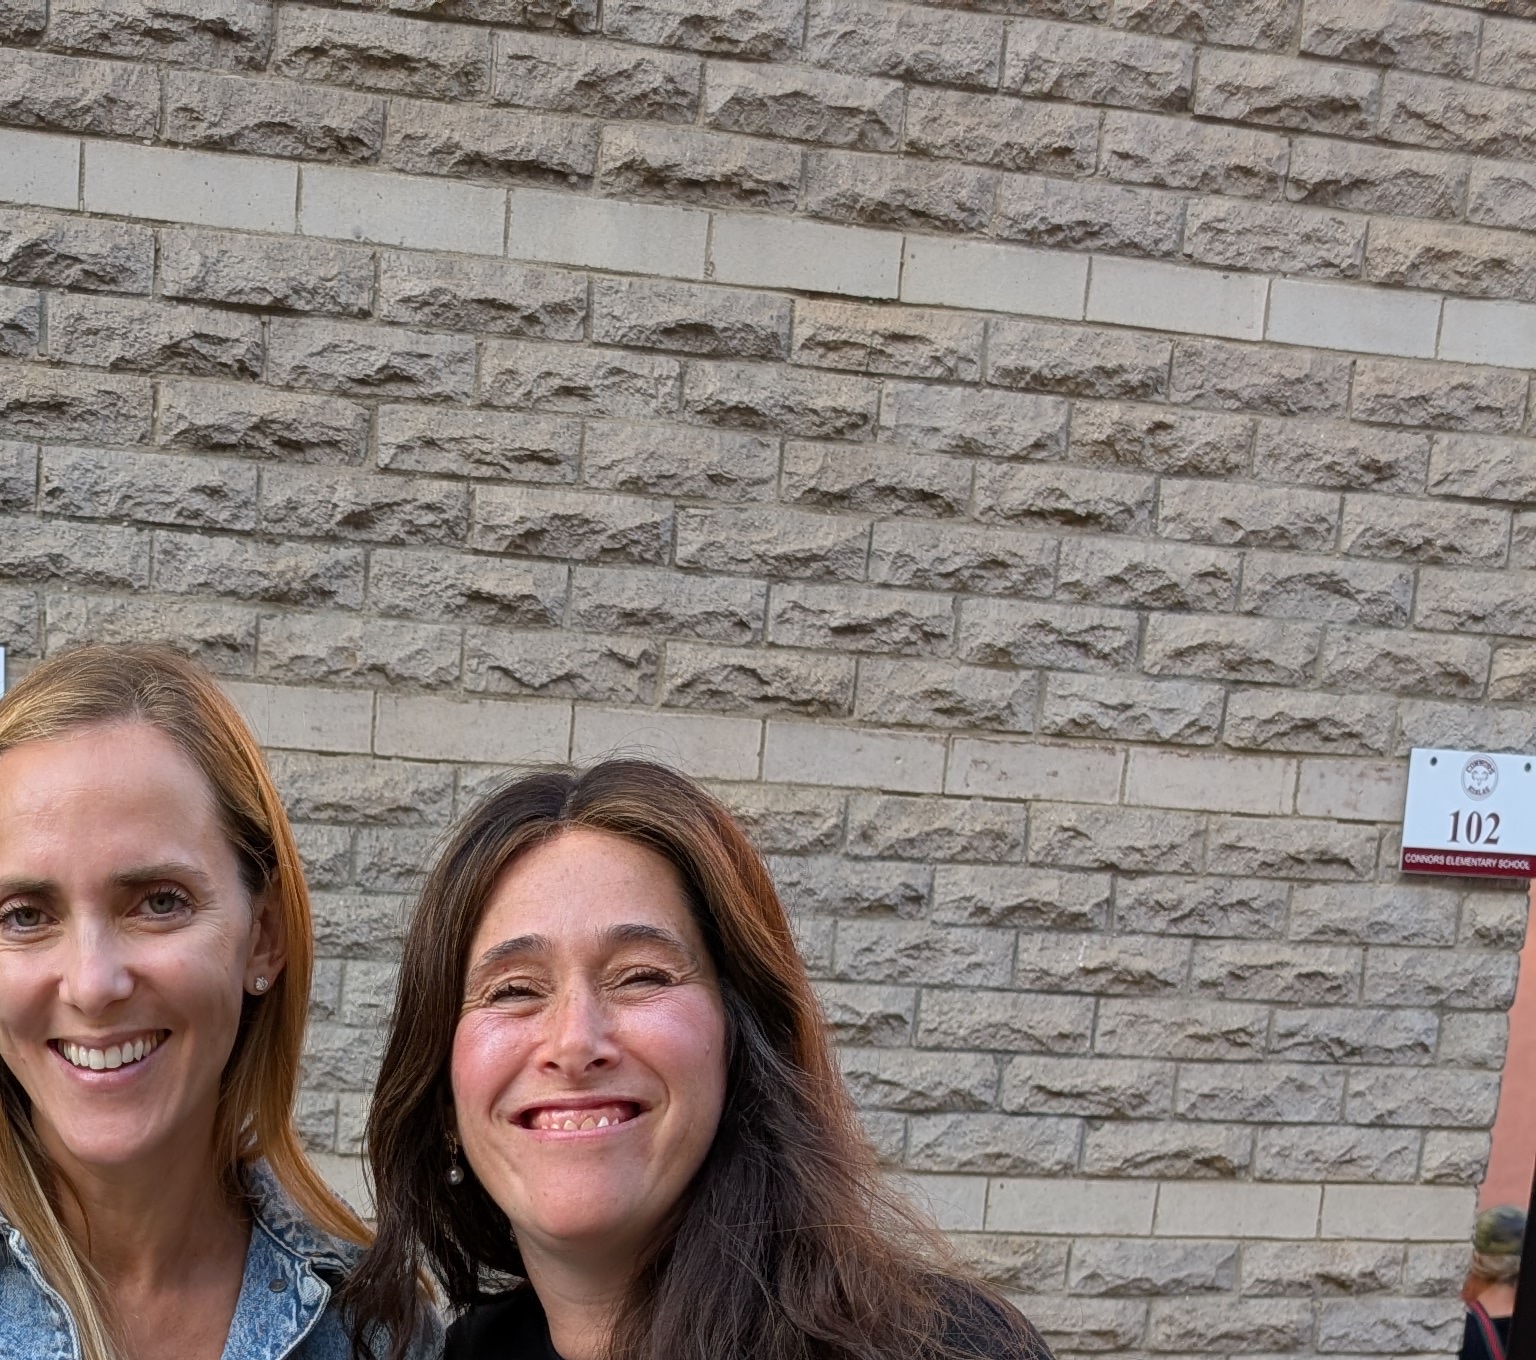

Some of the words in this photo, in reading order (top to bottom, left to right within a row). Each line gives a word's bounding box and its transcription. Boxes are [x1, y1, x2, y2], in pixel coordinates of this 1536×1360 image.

[1447, 809, 1501, 845] 102
[1404, 853, 1444, 865] CONNORS
[1445, 855, 1498, 867] ELEMENTARY
[1497, 858, 1531, 871] SCHOOL
